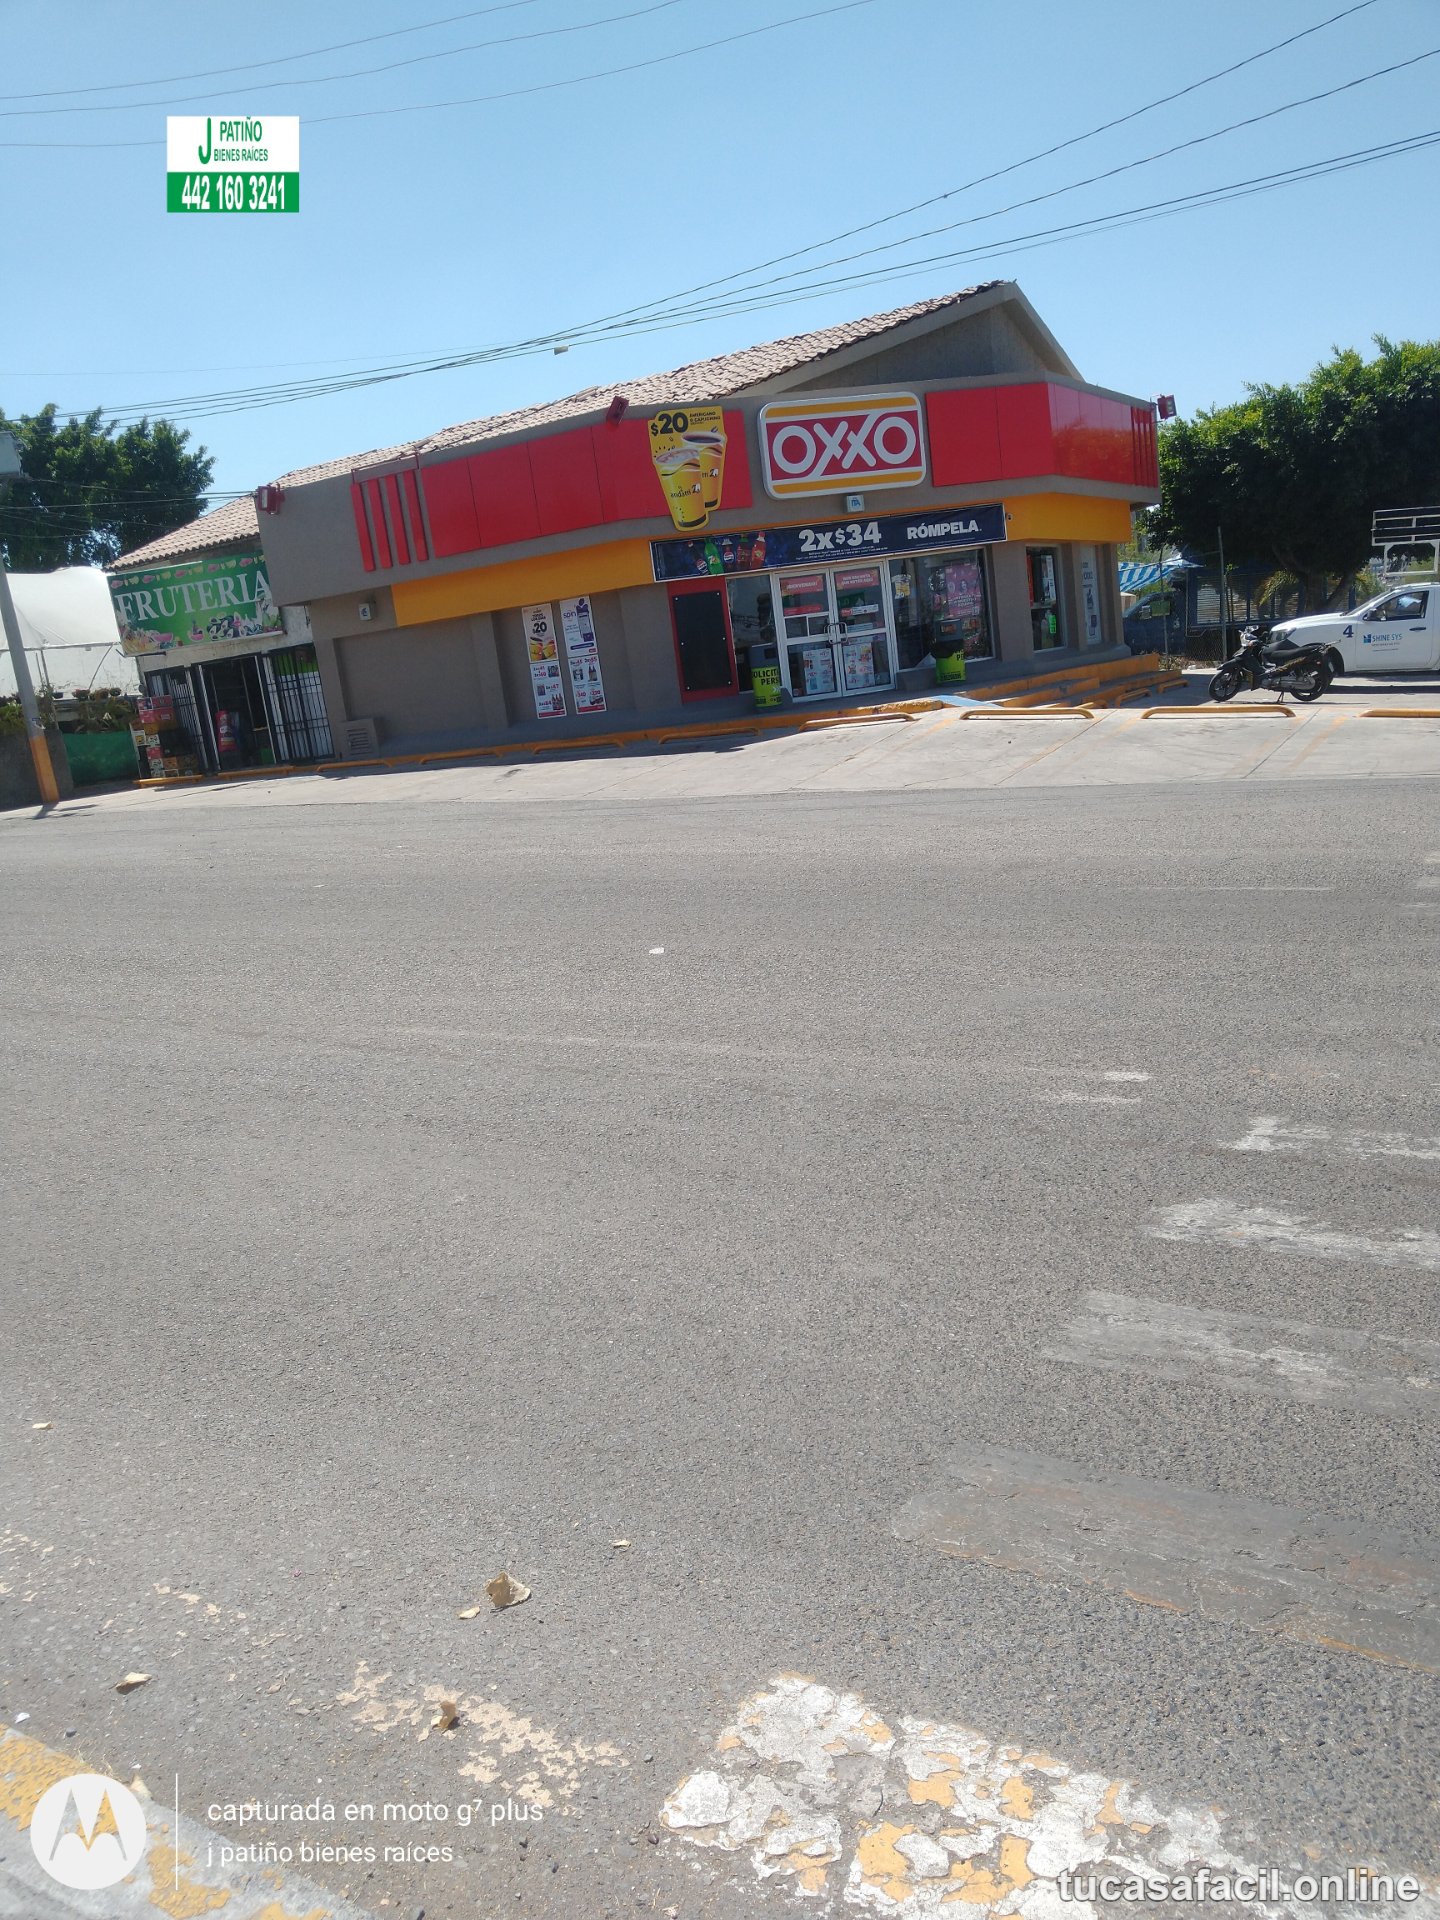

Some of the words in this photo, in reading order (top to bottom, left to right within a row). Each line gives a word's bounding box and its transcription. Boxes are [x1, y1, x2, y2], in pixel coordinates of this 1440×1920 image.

[651, 412, 688, 436] $20
[773, 414, 916, 476] OXXO
[115, 570, 271, 624] FRUTERIA
[1343, 625, 1354, 638] 4
[1372, 634, 1390, 642] SHINE
[1392, 633, 1402, 641] SYS
[752, 668, 779, 678] OLICIT
